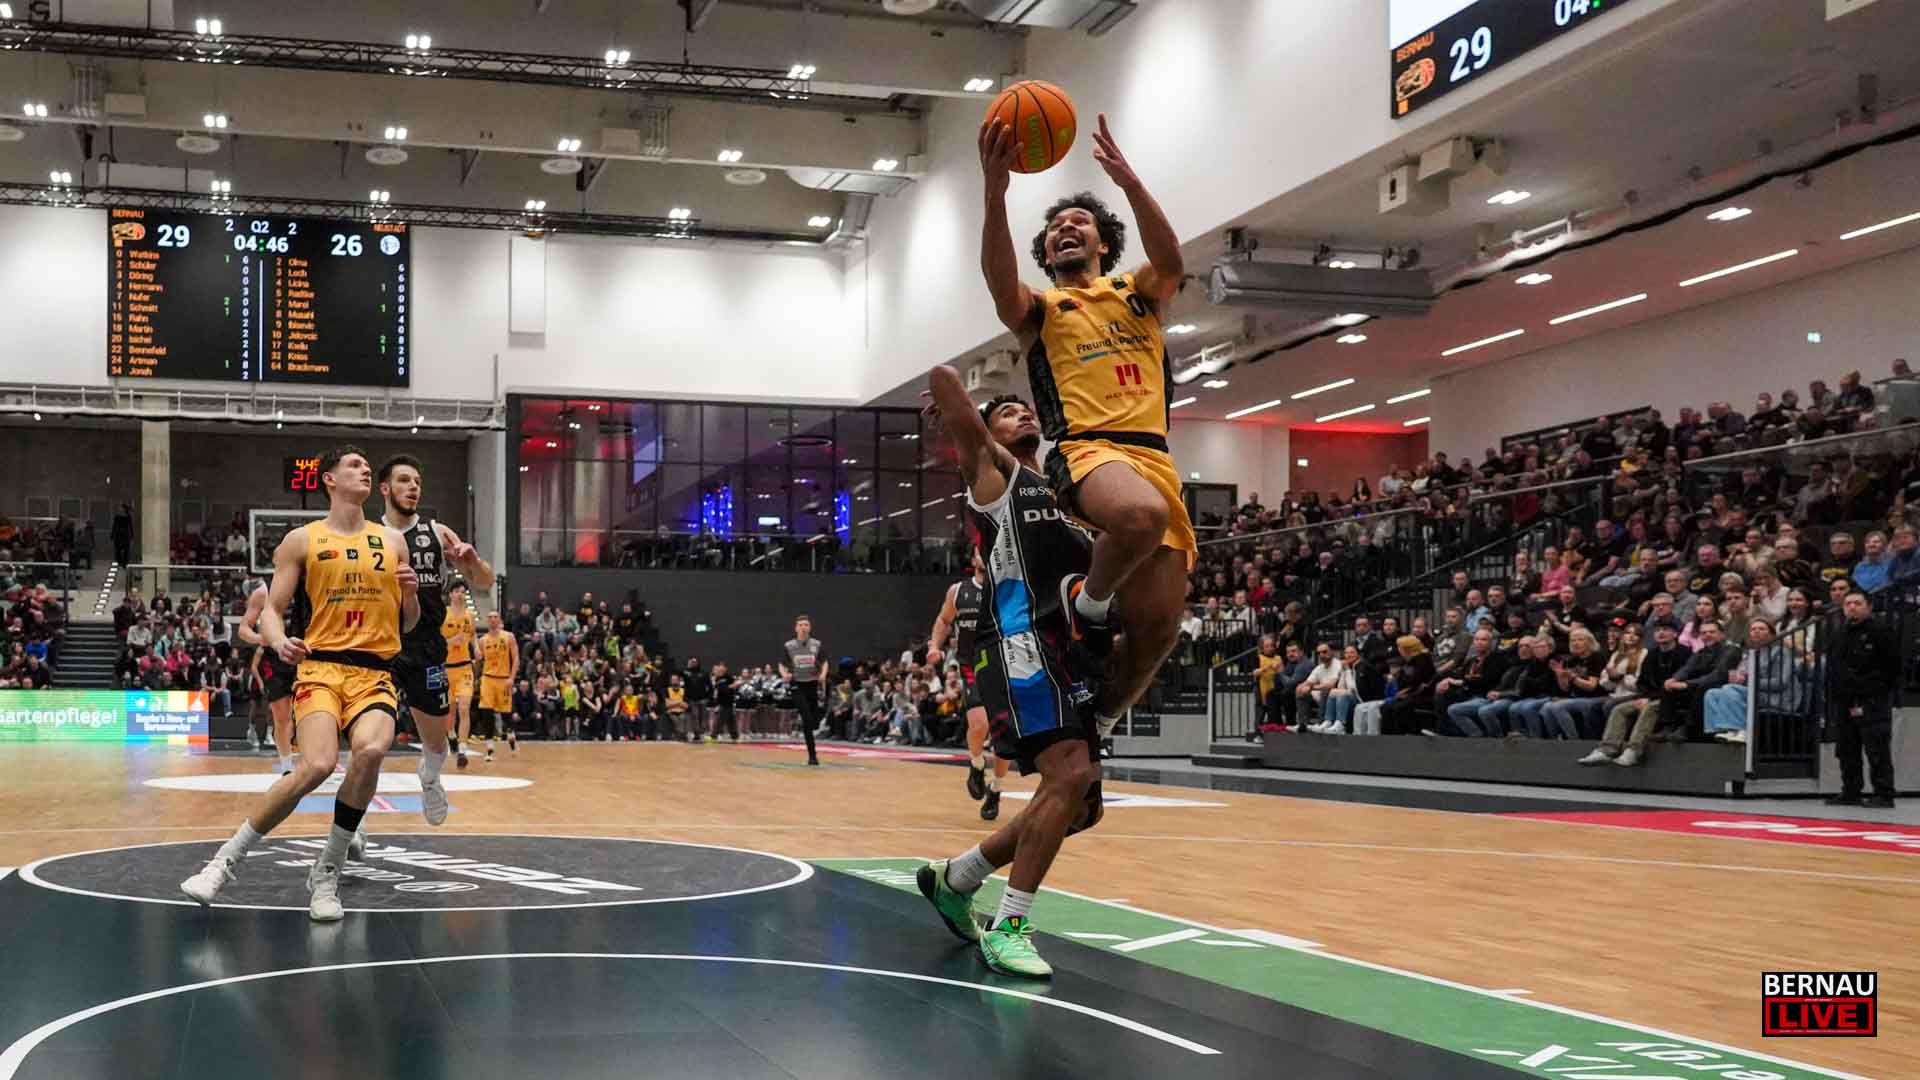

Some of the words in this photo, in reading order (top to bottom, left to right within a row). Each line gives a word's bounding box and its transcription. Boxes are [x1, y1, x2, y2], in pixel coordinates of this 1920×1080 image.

[1449, 26, 1492, 82] 29
[157, 224, 190, 247] 29
[225, 219, 234, 231] 2
[251, 220, 269, 233] Q2
[288, 222, 297, 235] 2
[234, 234, 288, 253] 04:46
[331, 234, 363, 256] 26
[1126, 293, 1146, 317] 0
[291, 470, 318, 489] 20
[1019, 487, 1054, 497] ROSS
[372, 552, 385, 572] 2
